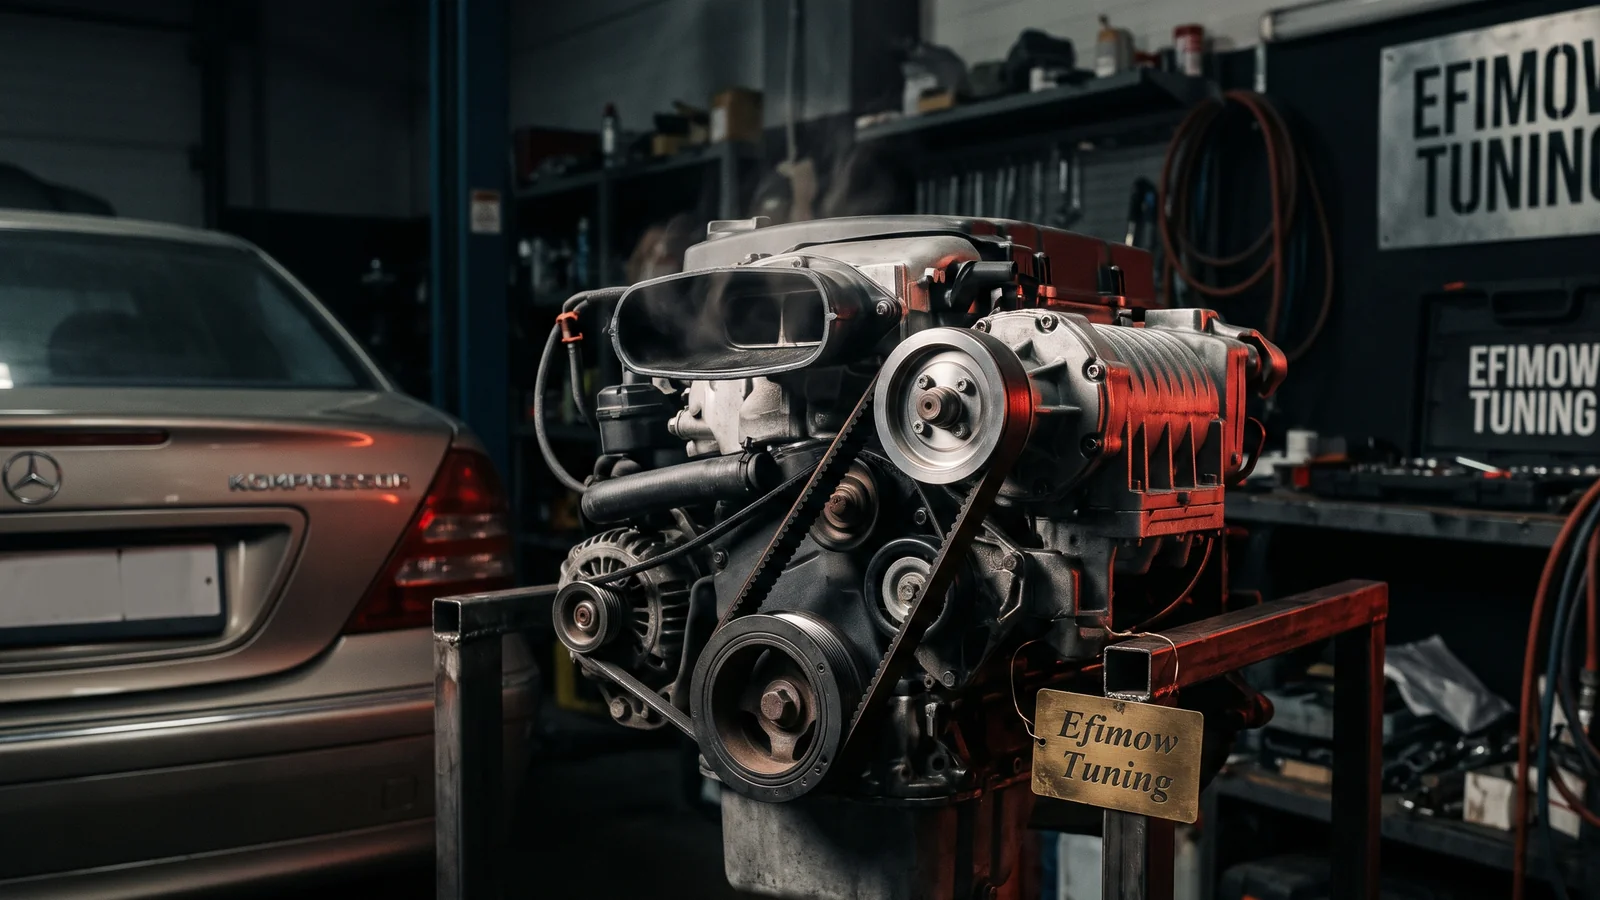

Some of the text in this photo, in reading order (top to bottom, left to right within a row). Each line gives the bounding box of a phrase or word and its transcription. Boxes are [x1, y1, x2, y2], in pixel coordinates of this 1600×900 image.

[1468, 343, 1600, 387] EFIMOW
[1469, 390, 1597, 436] TUNING
[1057, 709, 1179, 755] Efimow
[1062, 751, 1173, 803] Tuning
